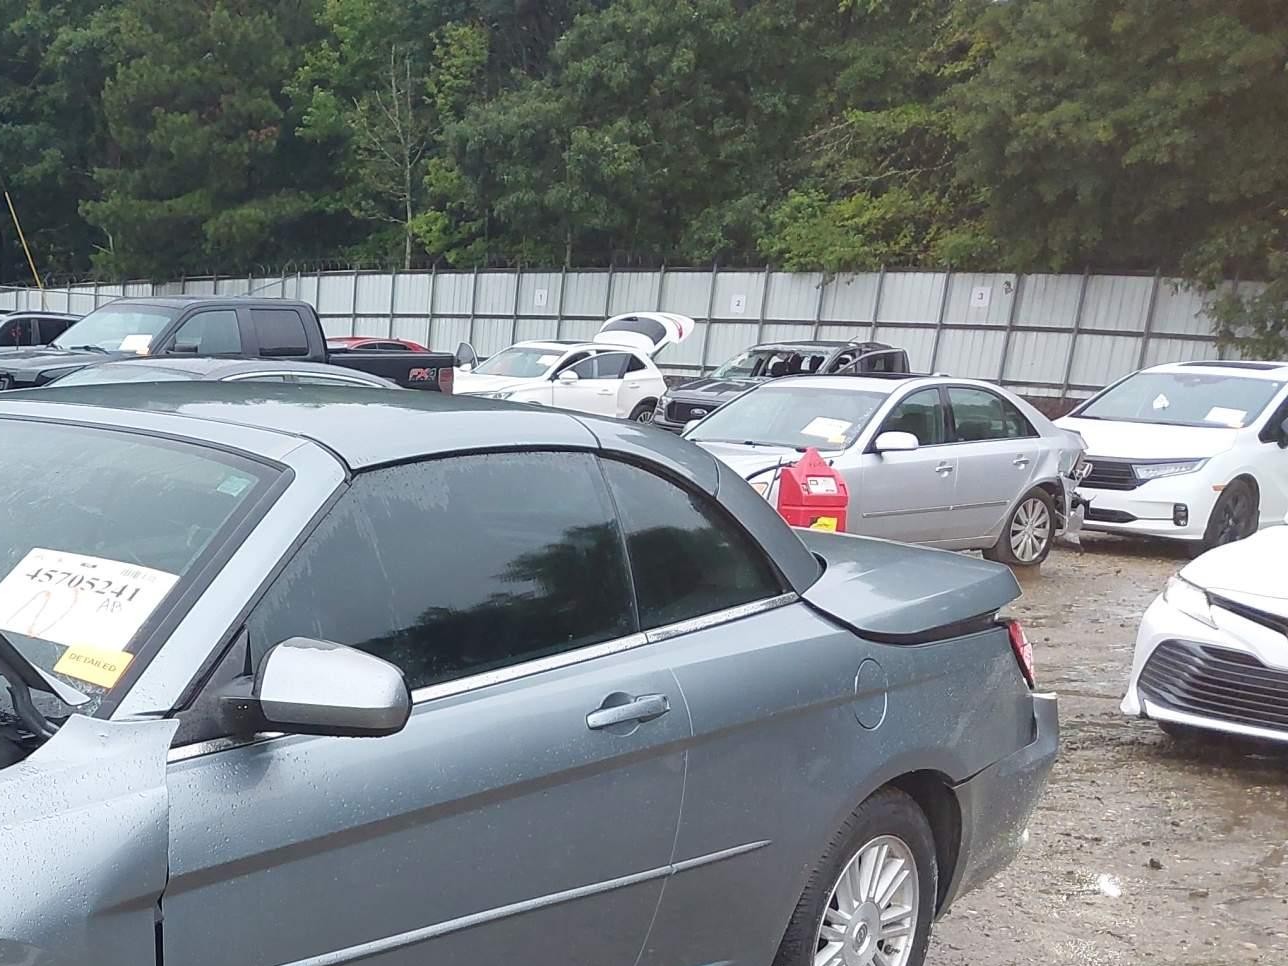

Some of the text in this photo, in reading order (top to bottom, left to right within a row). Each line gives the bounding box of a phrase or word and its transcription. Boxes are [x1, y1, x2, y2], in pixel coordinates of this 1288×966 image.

[408, 367, 437, 382] FX4
[24, 567, 141, 602] 45705241
[68, 652, 117, 673] DETAILED
